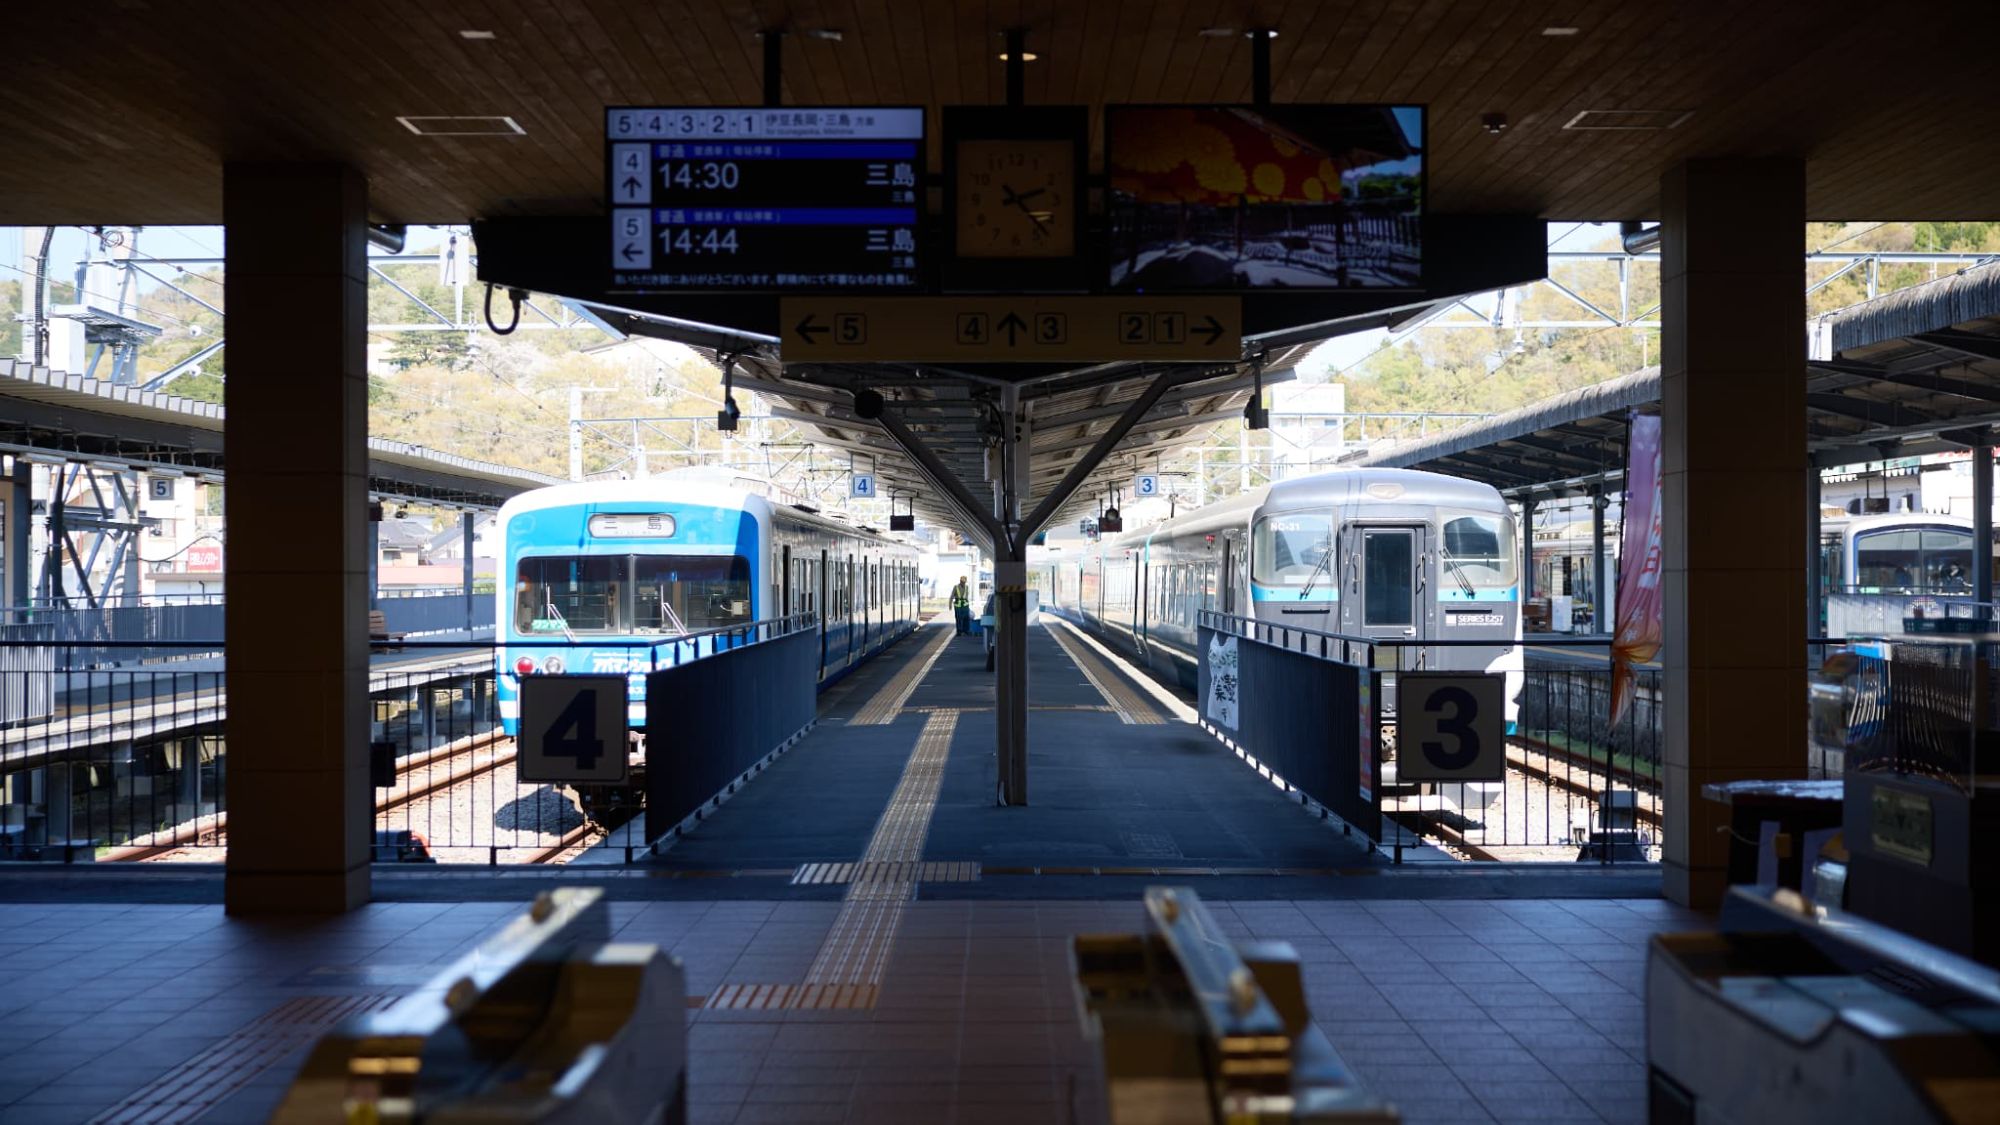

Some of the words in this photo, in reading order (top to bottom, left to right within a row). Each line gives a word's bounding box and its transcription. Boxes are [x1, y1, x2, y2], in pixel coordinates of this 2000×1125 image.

[618, 115, 632, 134] 5
[649, 115, 662, 133] 4
[681, 115, 694, 134] 3
[712, 115, 725, 133] 2
[743, 115, 754, 133] 1
[626, 153, 639, 170] 4
[659, 163, 739, 189] 14:30
[866, 163, 915, 187] 三島
[626, 218, 639, 236] 5
[659, 229, 739, 254] 14:44
[866, 229, 915, 252] 三島
[842, 317, 859, 341] 5
[963, 317, 982, 340] 4
[1042, 317, 1059, 341] 3
[1126, 317, 1143, 340] 2
[1162, 317, 1174, 340] 1
[156, 481, 167, 496] 5
[857, 478, 869, 493] 4
[1141, 478, 1153, 493] 3
[1270, 522, 1300, 532] NC-31
[1457, 615, 1485, 623] SERIES
[1485, 615, 1504, 623] E257
[542, 689, 604, 771] 4
[1421, 685, 1481, 771] 3
